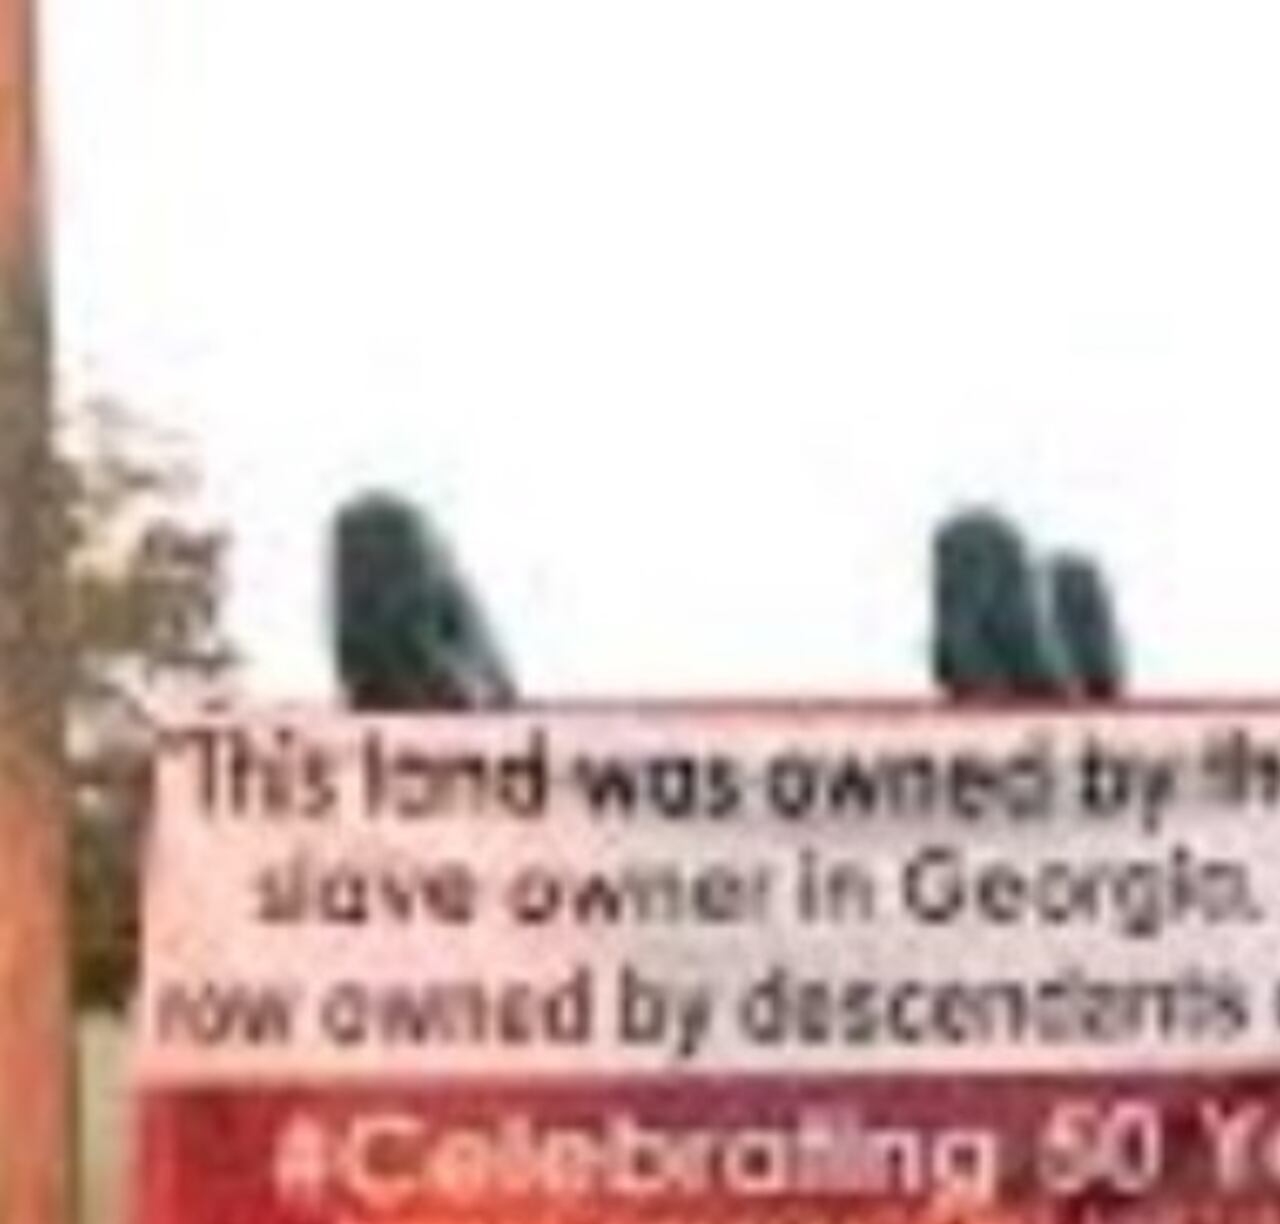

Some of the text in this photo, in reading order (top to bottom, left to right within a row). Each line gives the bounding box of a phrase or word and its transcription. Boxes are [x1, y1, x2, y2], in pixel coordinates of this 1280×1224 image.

[364, 730, 548, 818] land
[575, 750, 742, 818] was
[768, 742, 1052, 820] owned
[1080, 738, 1176, 834] by
[256, 852, 476, 922] slave
[510, 866, 768, 922] owner
[800, 850, 876, 922] in
[320, 966, 590, 1044] owned
[620, 966, 708, 1056] by
[1040, 1102, 1160, 1196] 50
